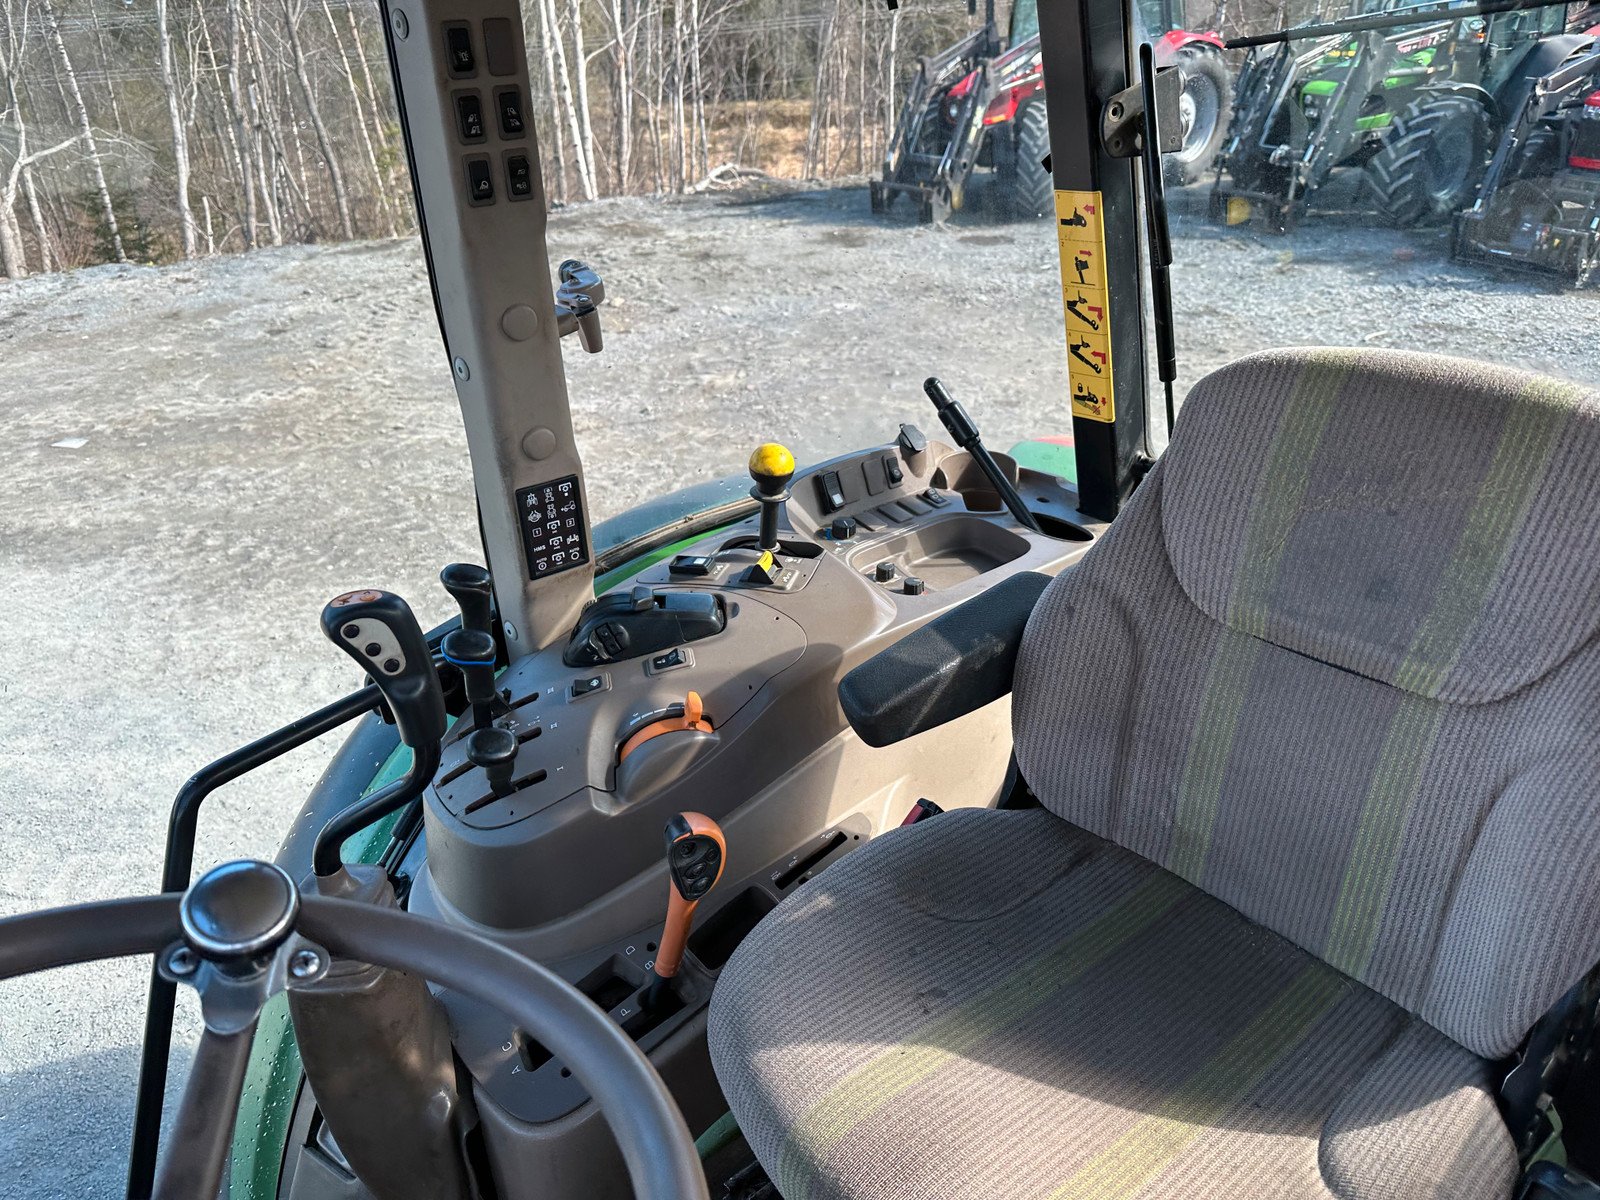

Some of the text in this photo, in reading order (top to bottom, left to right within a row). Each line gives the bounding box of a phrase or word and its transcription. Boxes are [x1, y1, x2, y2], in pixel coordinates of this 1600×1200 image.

[625, 945, 636, 955] D
[644, 960, 655, 970] B
[620, 1008, 632, 1017] P
[501, 1041, 512, 1052] C
[511, 1064, 521, 1074] A
